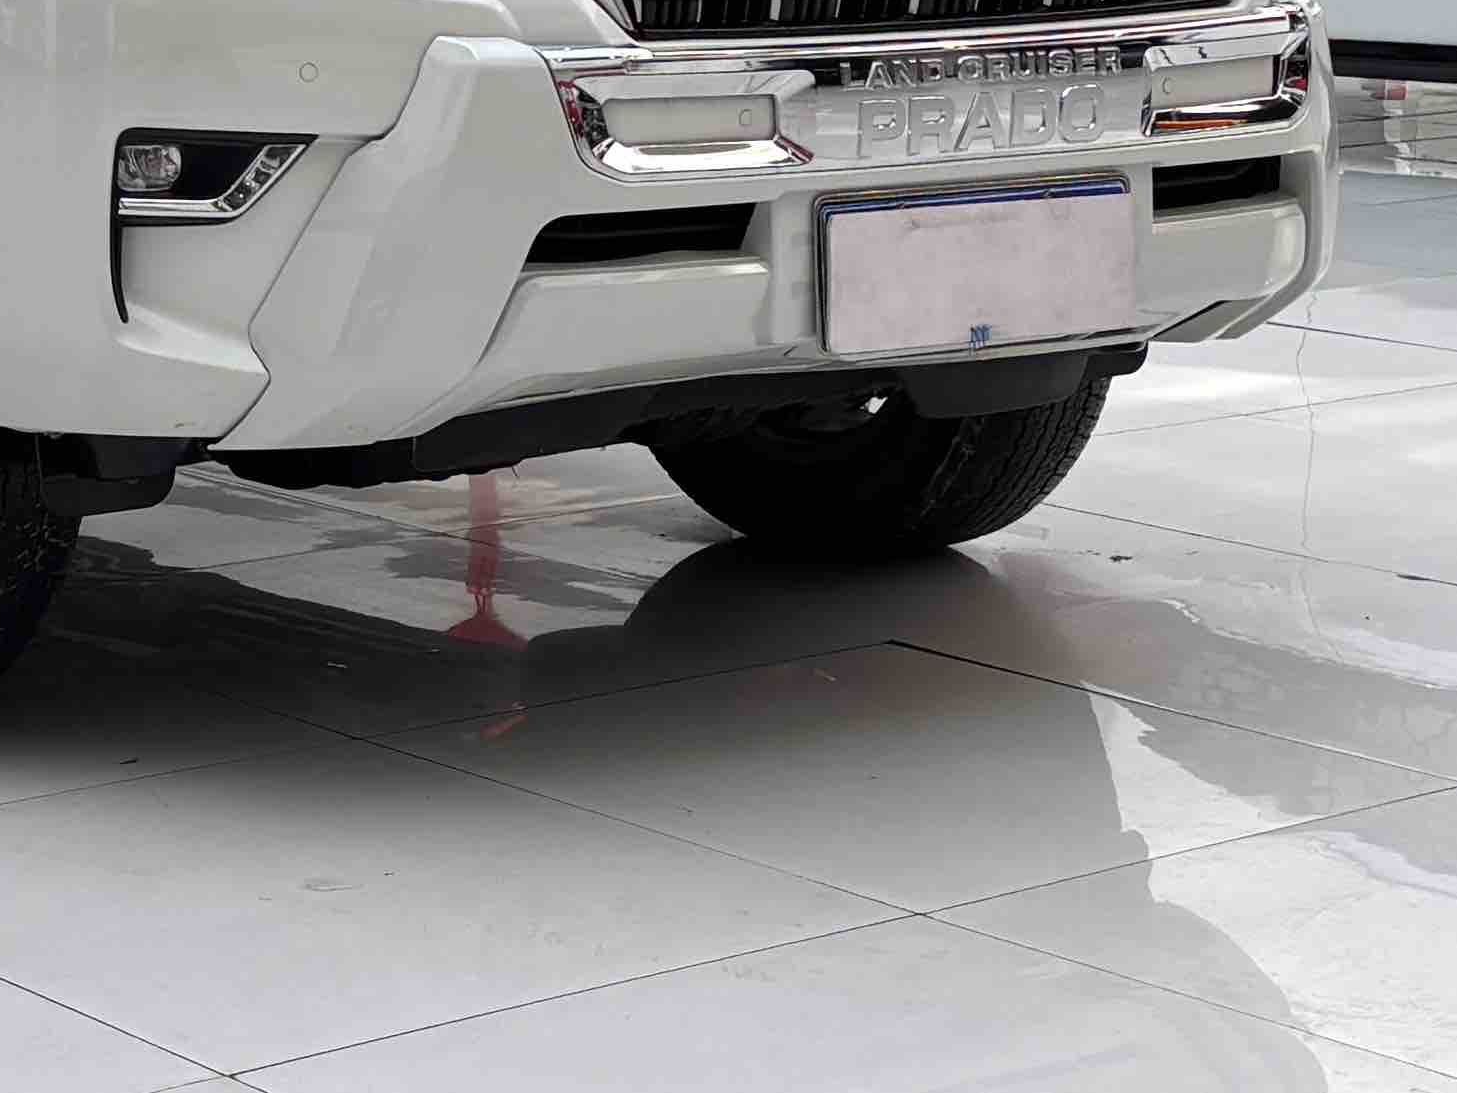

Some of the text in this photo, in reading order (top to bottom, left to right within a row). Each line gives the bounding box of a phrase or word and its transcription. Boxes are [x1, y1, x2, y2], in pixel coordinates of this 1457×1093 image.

[840, 46, 1122, 90] LAND CRUISER
[857, 84, 1106, 159] PRADO
